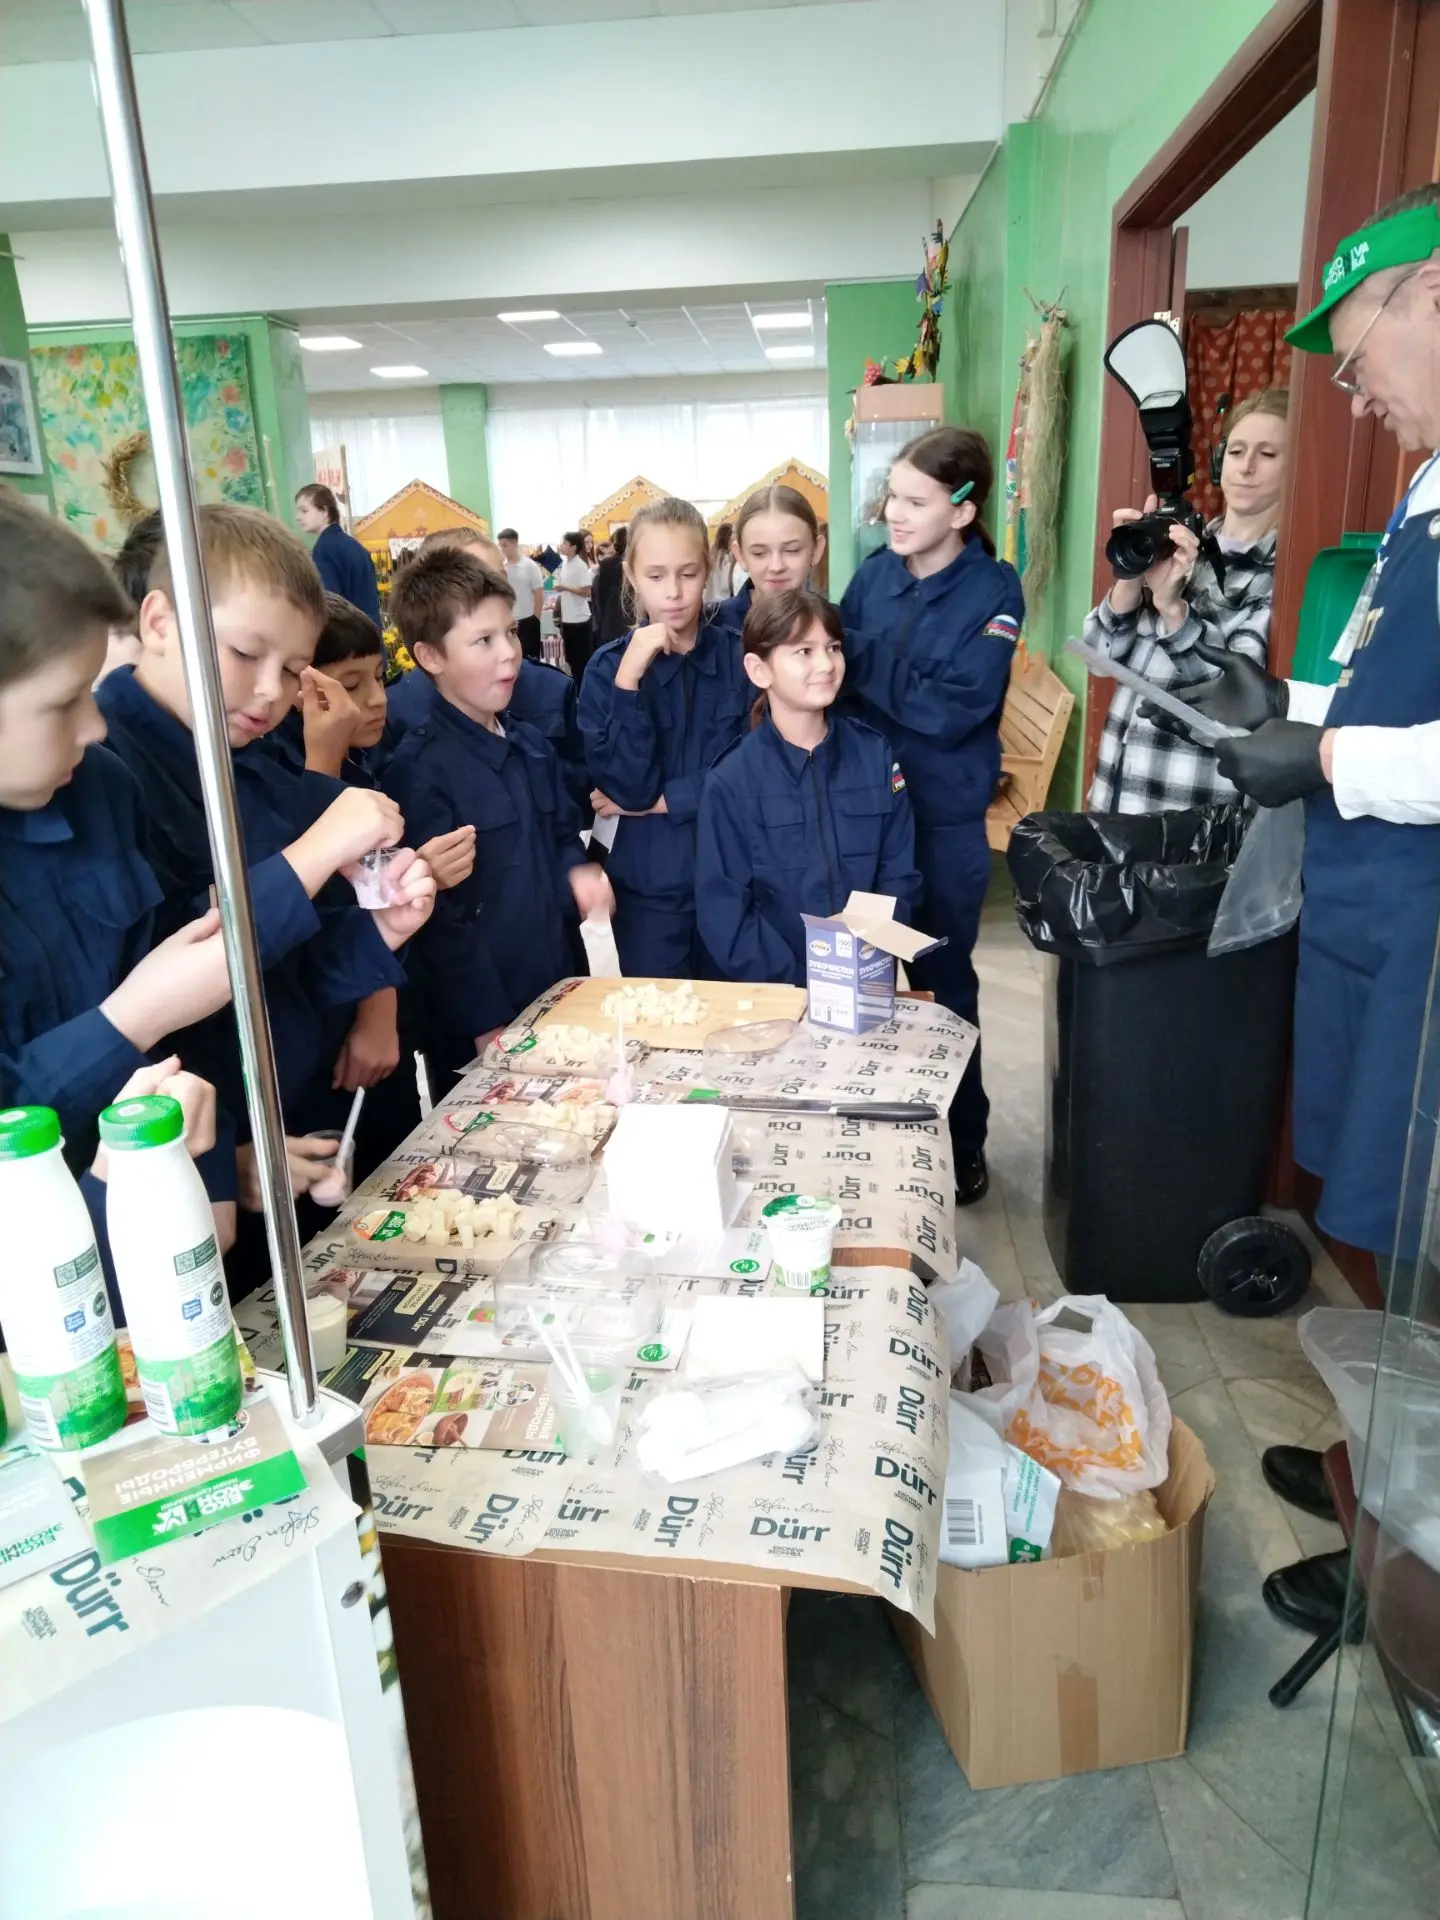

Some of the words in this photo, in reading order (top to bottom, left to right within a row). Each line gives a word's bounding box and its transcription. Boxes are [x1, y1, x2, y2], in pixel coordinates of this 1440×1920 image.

[822, 1151, 871, 1161] Dürr
[912, 1146, 933, 1172] Dürr
[839, 1175, 861, 1200] Dürr
[916, 1215, 937, 1254] Dürr
[907, 1285, 929, 1326] Dürr
[889, 1337, 944, 1380] Dürr
[813, 1386, 855, 1408] ürr
[896, 1385, 925, 1435] Dürr
[115, 1436, 258, 1494] БУТЕРБРОДЫ
[118, 1447, 261, 1506] ФИРМЕННЫЕ
[875, 1456, 938, 1507] Dürr
[464, 1493, 520, 1545] Dürr
[557, 1498, 610, 1523] ürr
[654, 1495, 699, 1549] Dürr
[750, 1516, 831, 1543] Dürr
[880, 1517, 914, 1590] Dürr
[50, 1550, 130, 1637] Dürr
